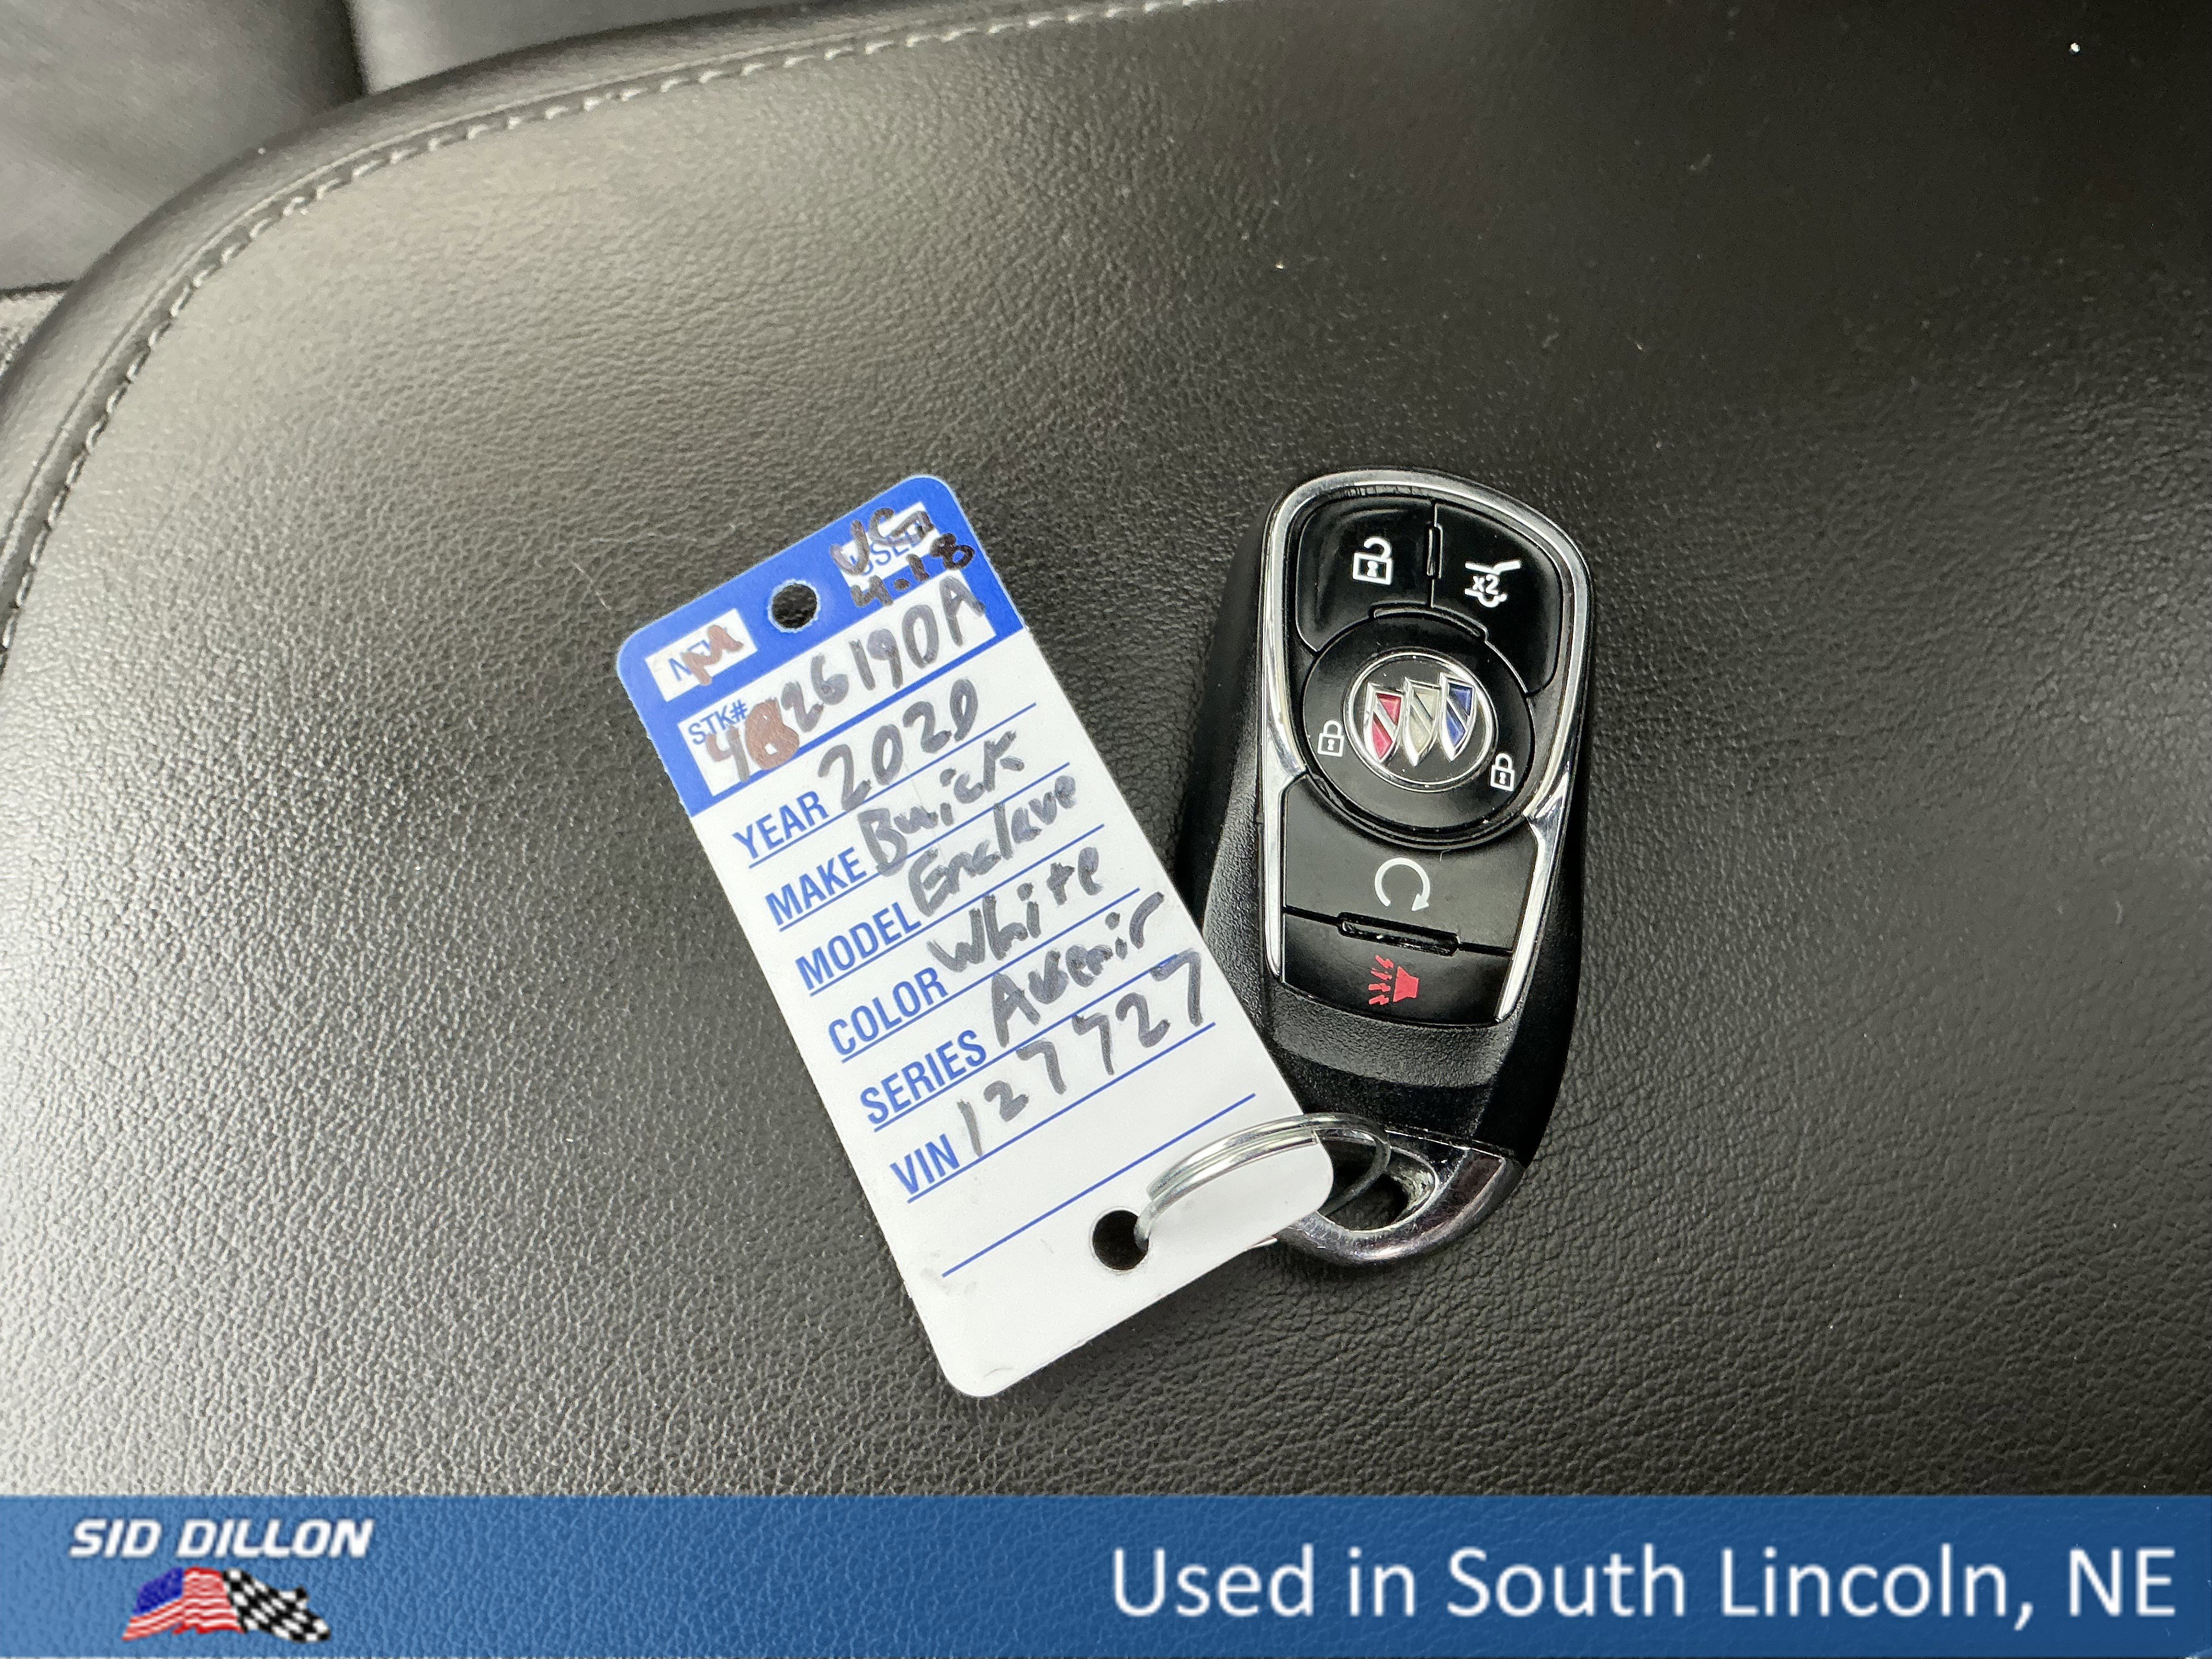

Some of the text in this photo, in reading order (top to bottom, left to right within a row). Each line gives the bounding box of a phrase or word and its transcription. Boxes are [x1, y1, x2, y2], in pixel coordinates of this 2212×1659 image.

[688, 699, 748, 745] STK#
[817, 679, 978, 811] 2020
[732, 790, 829, 860] YEAR
[858, 731, 1025, 876] Buick
[907, 775, 1076, 917] Enclave
[765, 847, 867, 926] MAKE
[927, 847, 1103, 973] White
[795, 901, 922, 991] MODEL
[828, 966, 949, 1056] COLOR
[957, 949, 1202, 1158] 127727
[859, 1029, 988, 1126] SERIES
[889, 1133, 961, 1195] VIN
